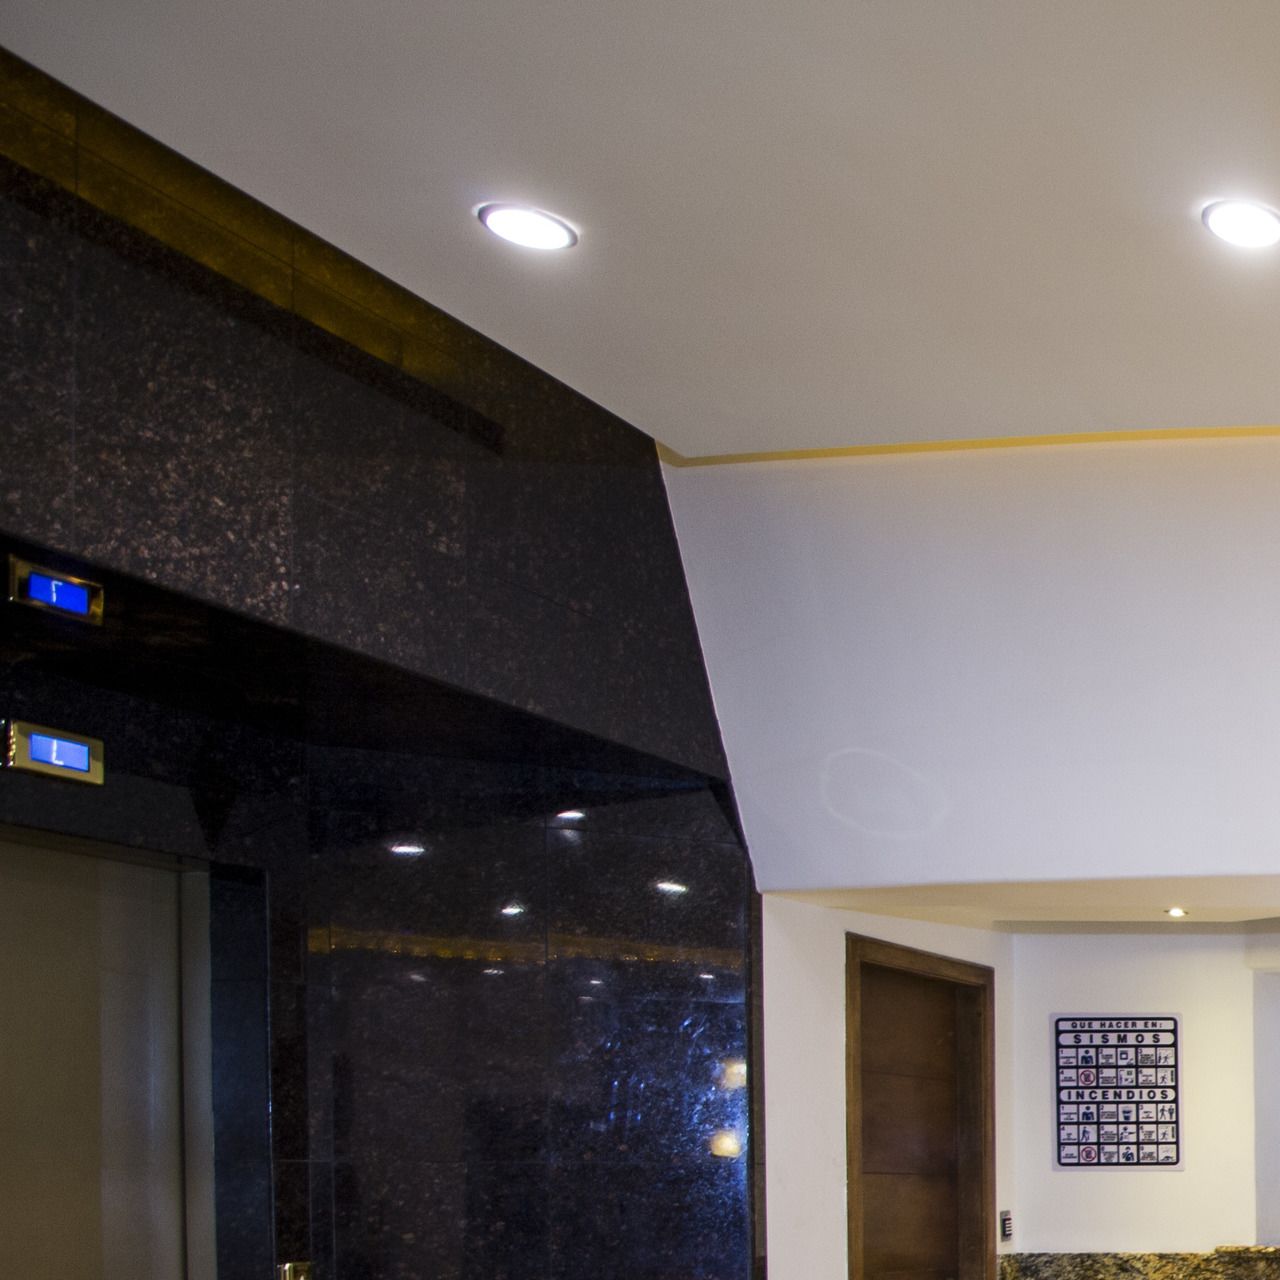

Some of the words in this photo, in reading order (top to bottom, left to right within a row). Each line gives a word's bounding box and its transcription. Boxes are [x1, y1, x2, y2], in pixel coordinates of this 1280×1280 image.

[1100, 1021, 1137, 1029] HACER
[1144, 1021, 1163, 1029] EN:
[1074, 1034, 1161, 1044] SISMOS
[1067, 1090, 1169, 1100] INCENDIOS
